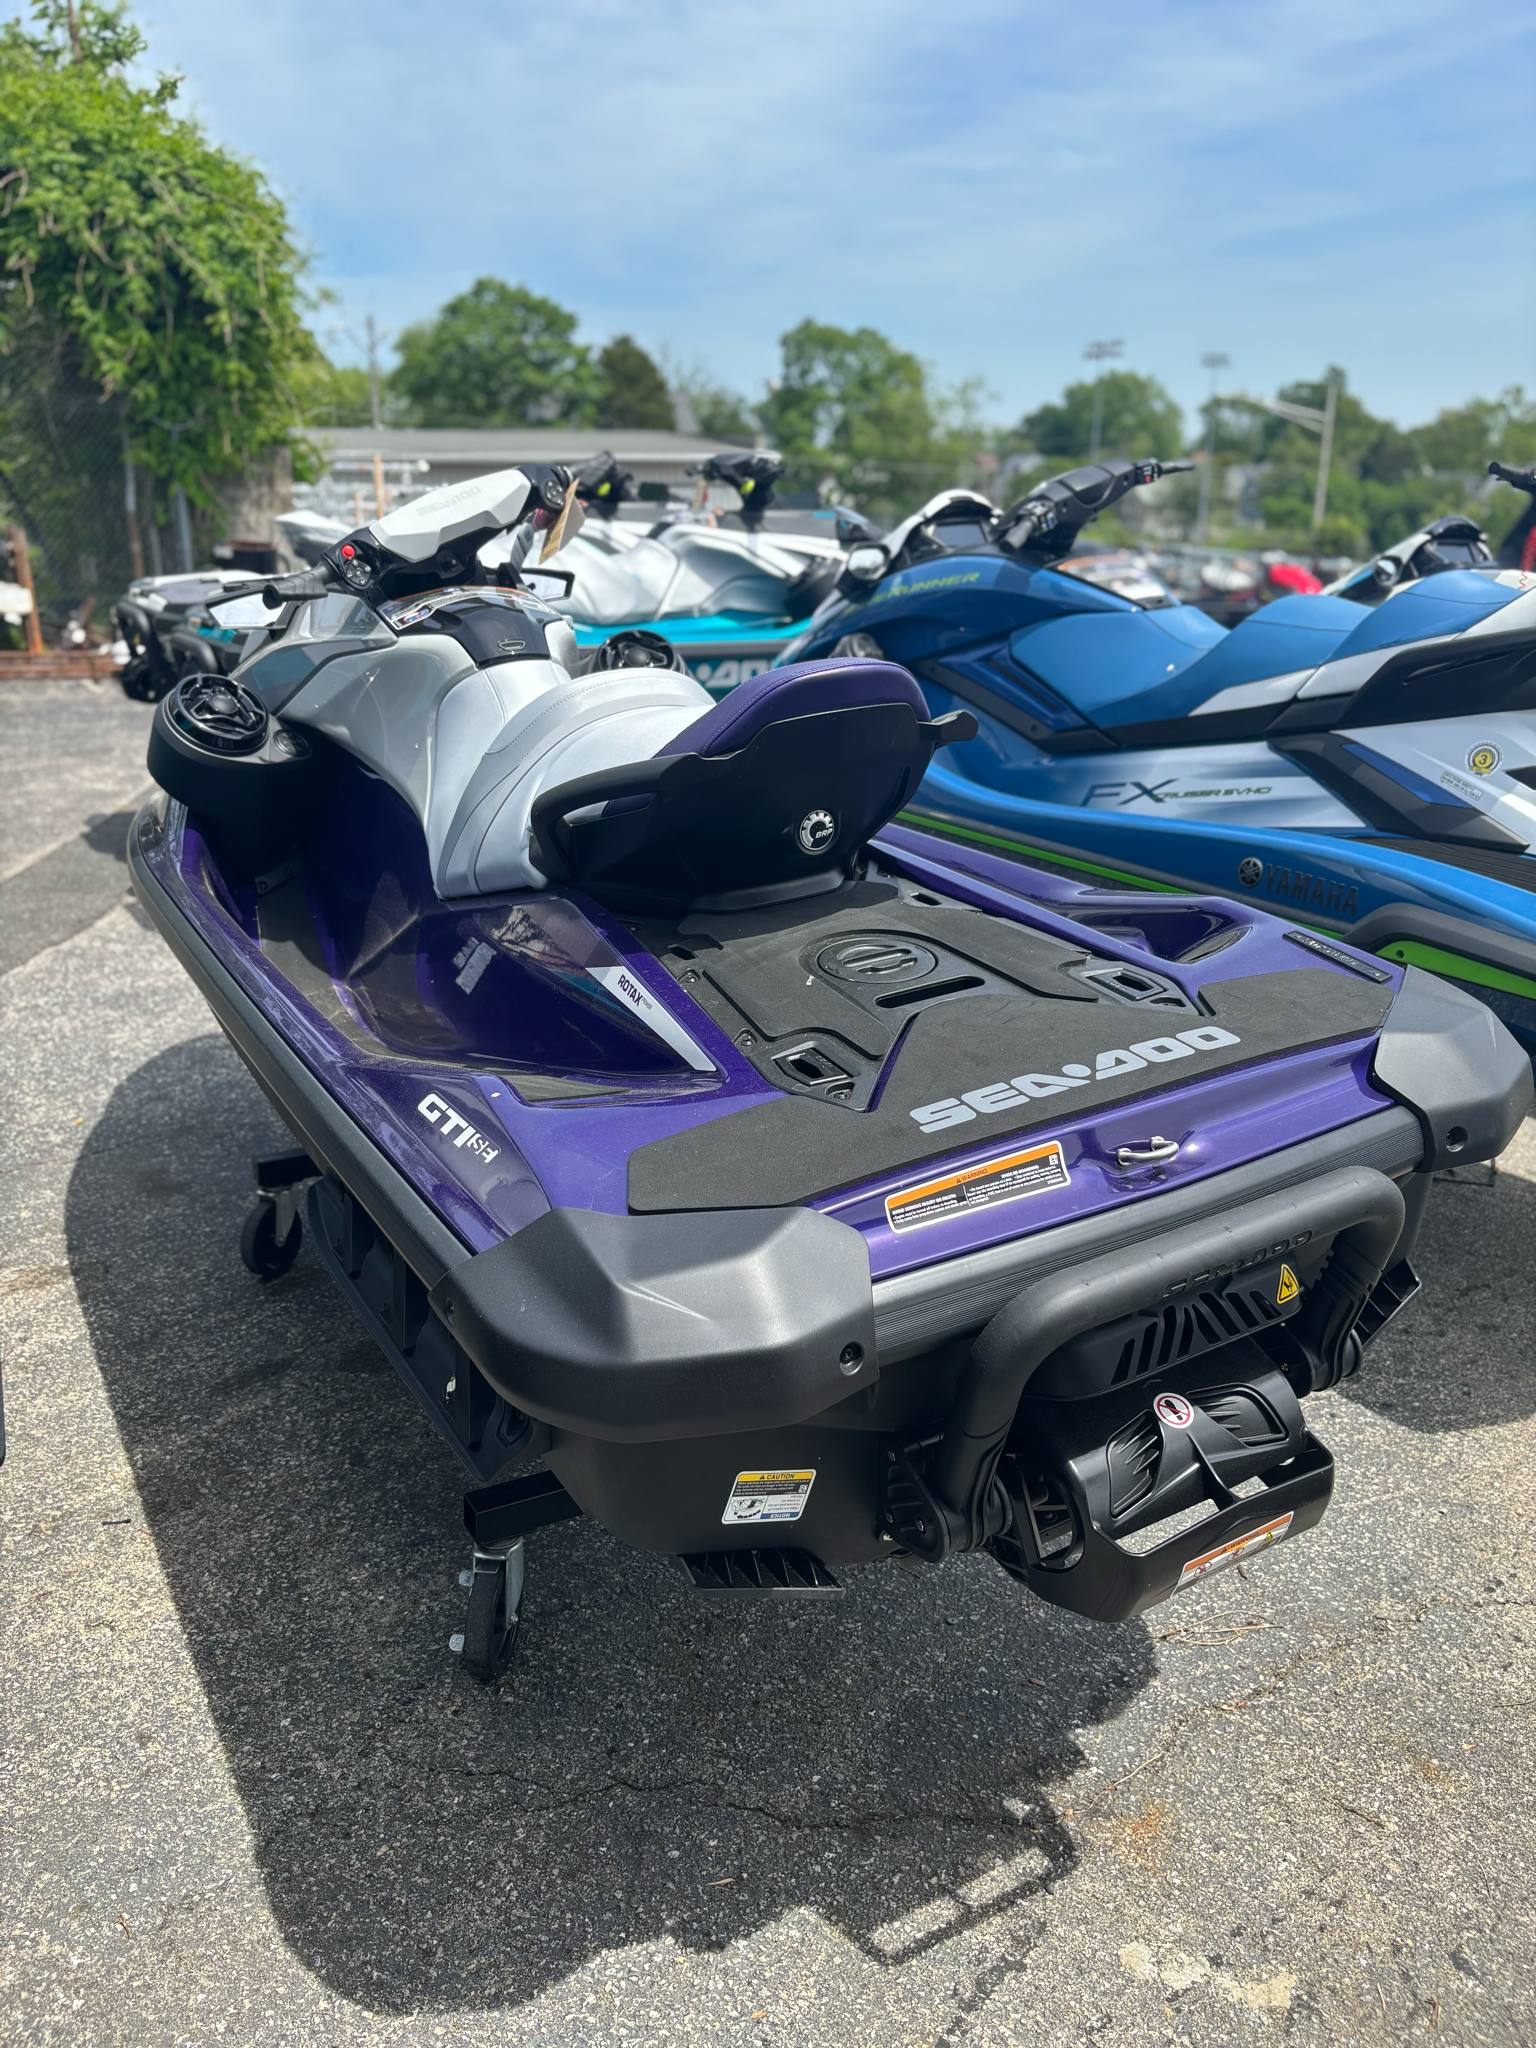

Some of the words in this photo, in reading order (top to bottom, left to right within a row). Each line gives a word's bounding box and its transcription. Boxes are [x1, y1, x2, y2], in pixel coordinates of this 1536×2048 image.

[1081, 777, 1179, 808] FX
[815, 828, 833, 839] BRP
[1265, 863, 1359, 917] YAMAHA
[617, 974, 643, 1007] ROTAX
[417, 1093, 477, 1149] GTI
[961, 1168, 989, 1182] WARNING
